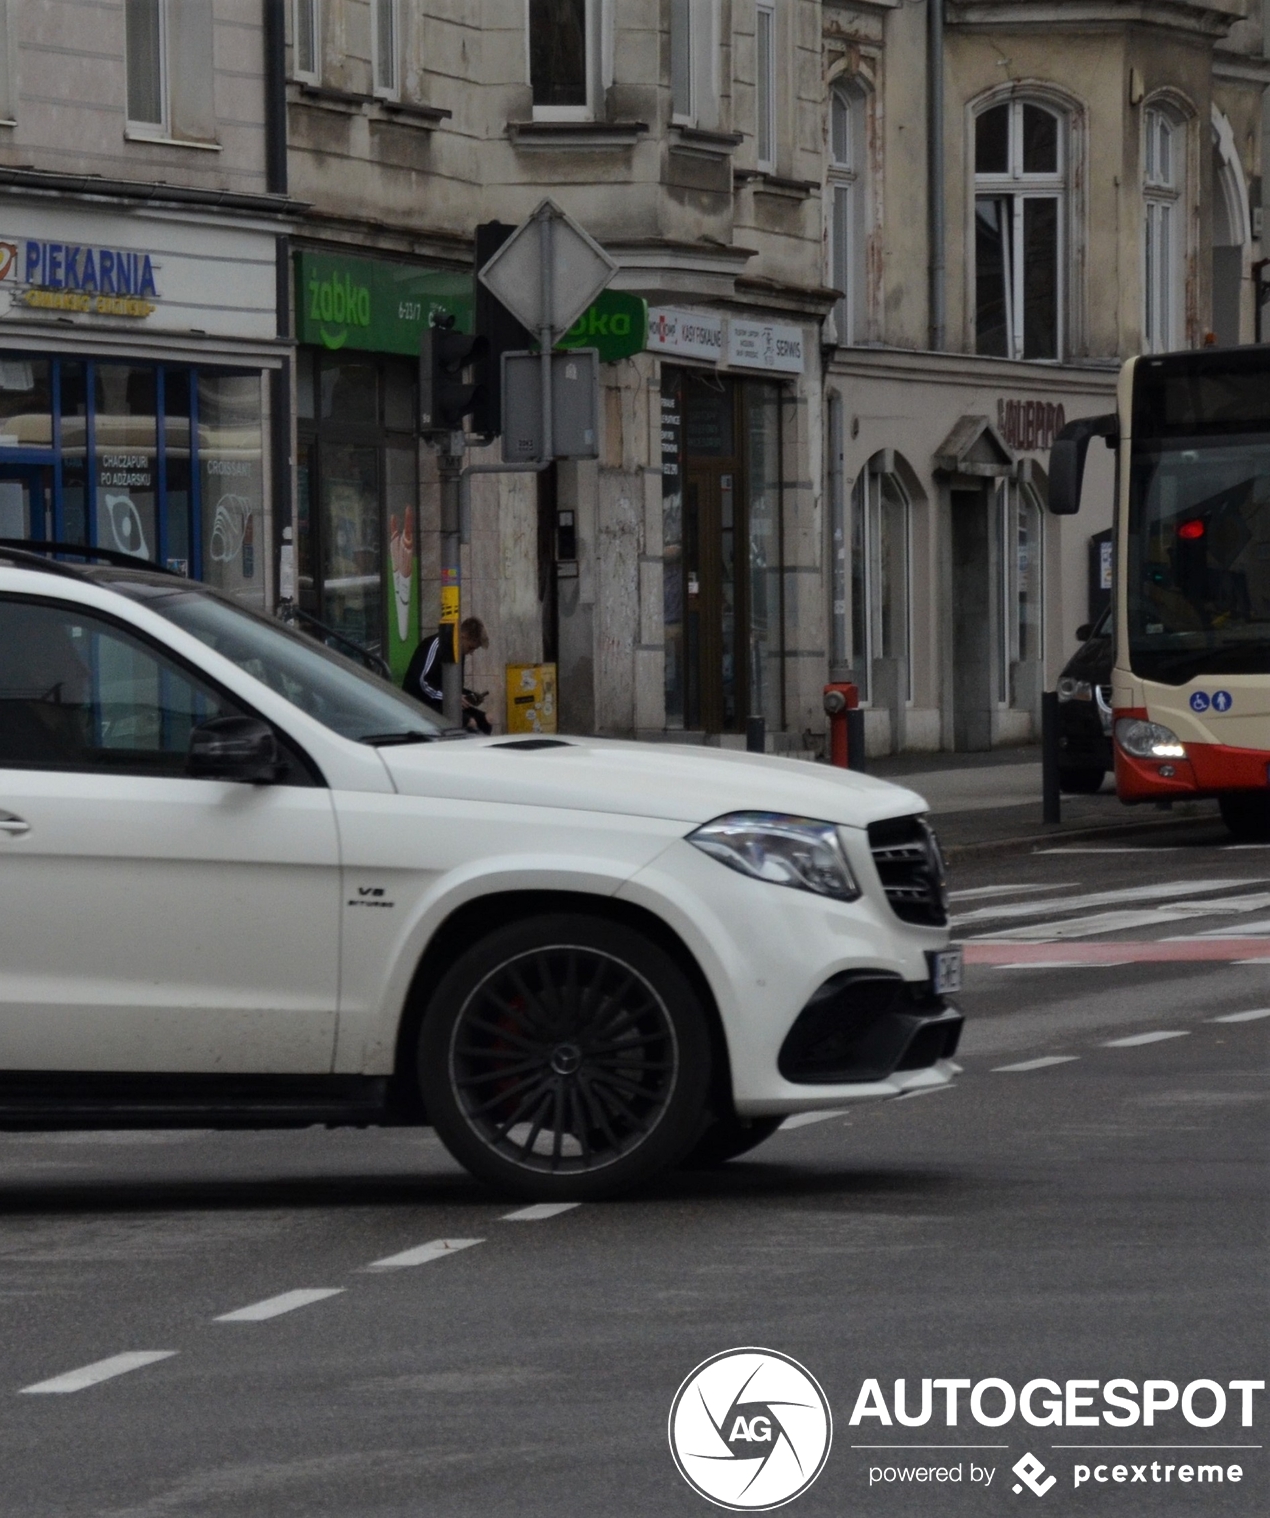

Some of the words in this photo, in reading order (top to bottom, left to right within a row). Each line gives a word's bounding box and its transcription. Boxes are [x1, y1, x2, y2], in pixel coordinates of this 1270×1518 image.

[25, 241, 157, 297] PIEKARNIA
[309, 267, 370, 326] żabka
[697, 327, 722, 347] FISKALNE
[776, 339, 801, 358] SERWIS
[103, 455, 148, 469] CHACZAPURI
[207, 460, 252, 478] CROISSANT
[101, 473, 112, 485] PO
[113, 470, 151, 486] ADŻARSKU
